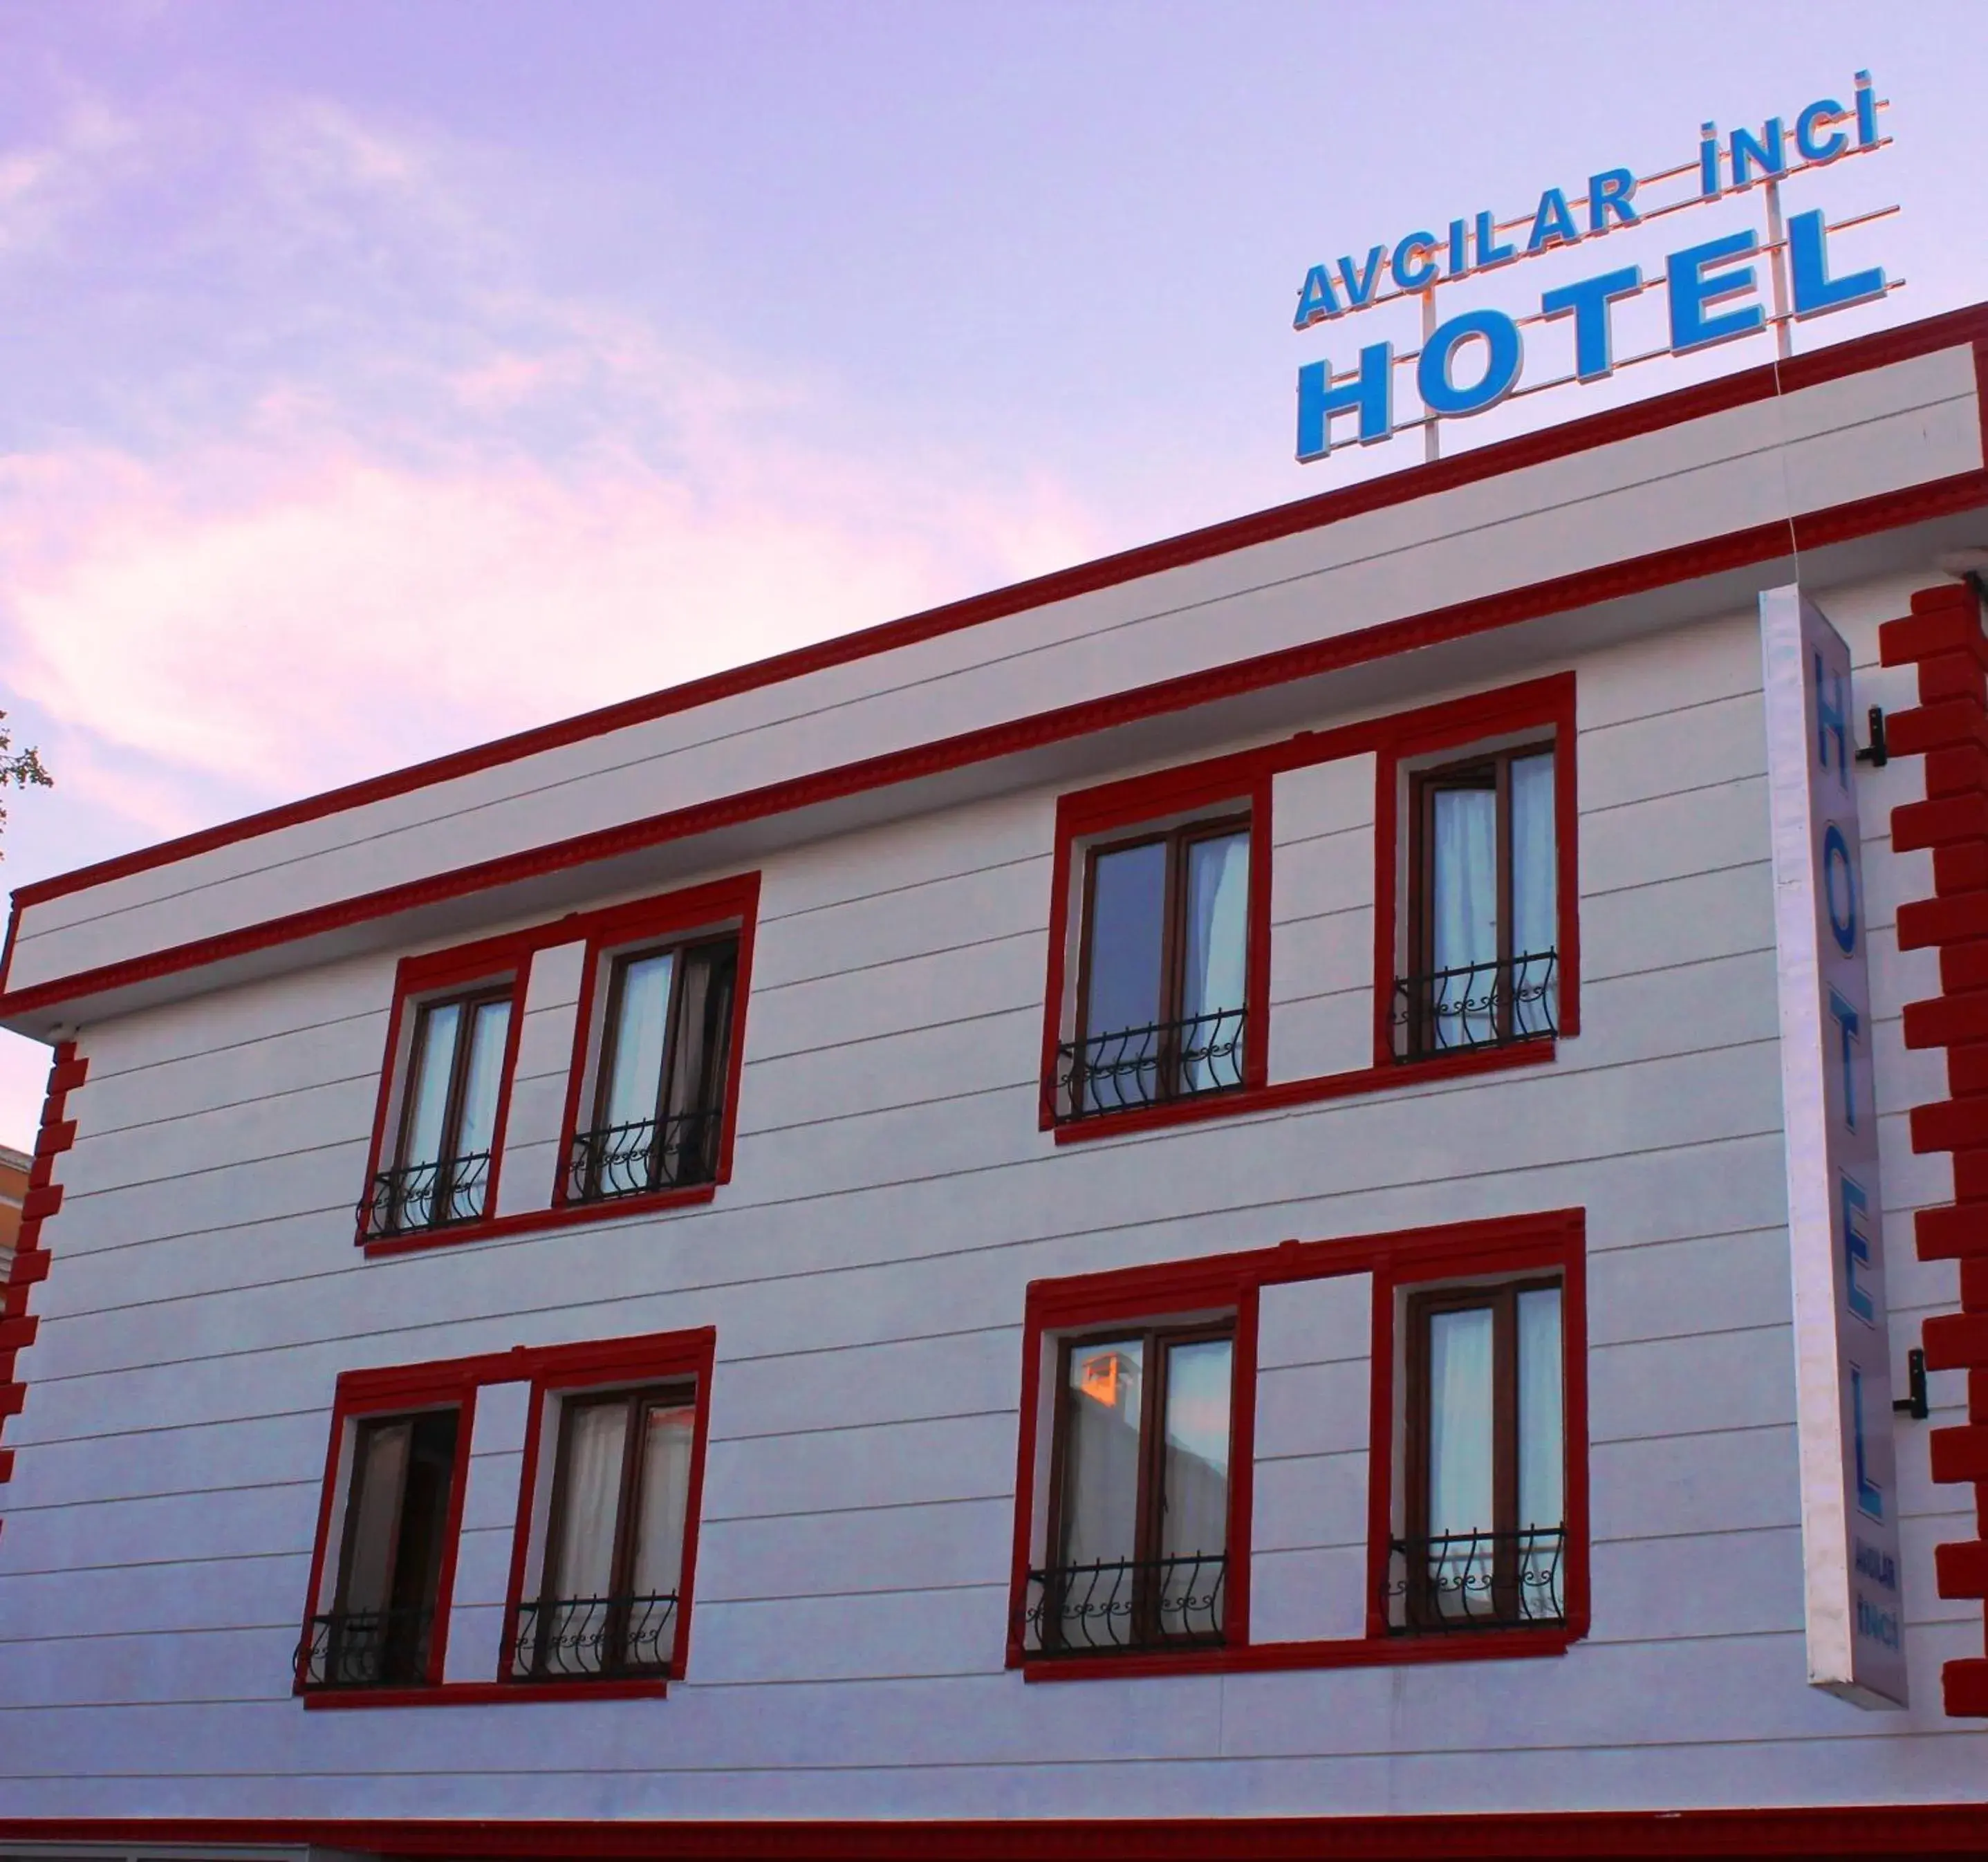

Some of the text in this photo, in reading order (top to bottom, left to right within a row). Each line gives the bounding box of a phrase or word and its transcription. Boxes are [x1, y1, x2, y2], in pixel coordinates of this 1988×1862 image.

[1293, 69, 1879, 330] AVCILAR İNCİ
[1295, 208, 1887, 464] HOTEL
[1813, 647, 1884, 1525] HOTEL
